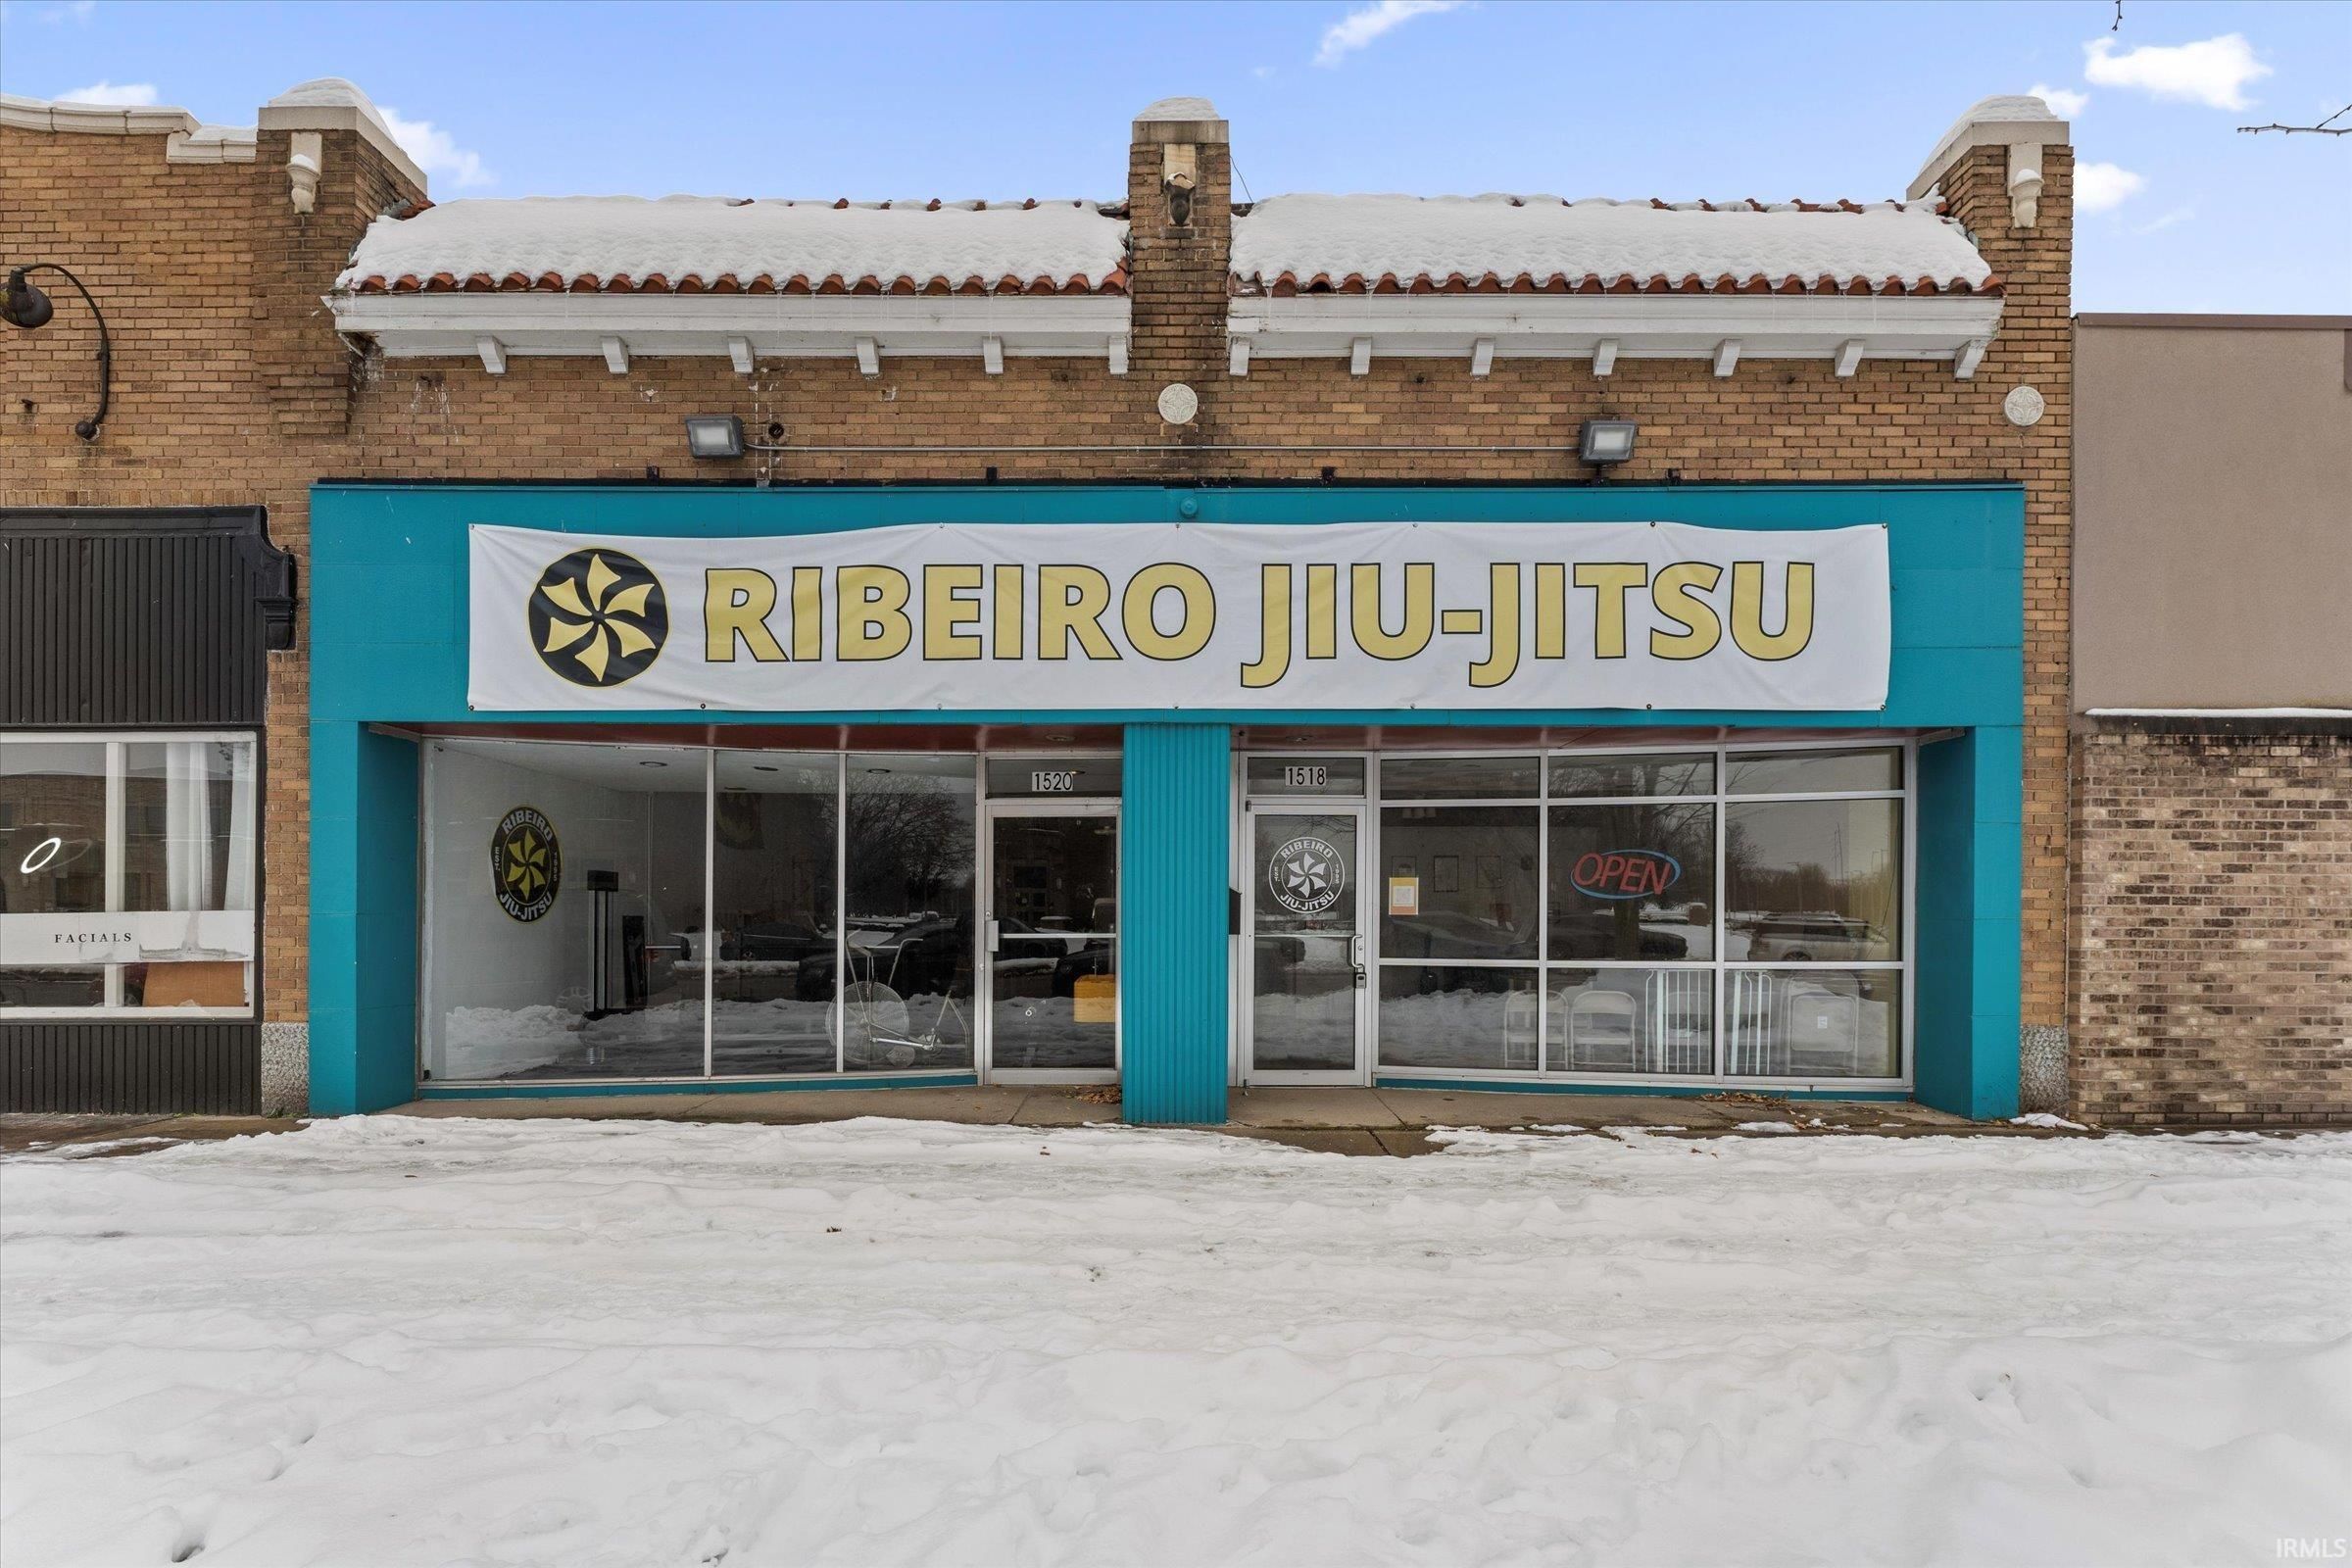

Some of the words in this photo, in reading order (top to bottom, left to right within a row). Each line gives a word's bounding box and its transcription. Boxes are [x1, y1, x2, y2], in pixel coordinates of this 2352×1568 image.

[704, 562, 1217, 663] RIBEIRO
[1240, 561, 1815, 689] JIU-JITSU
[1035, 772, 1073, 791] 1520
[1288, 767, 1326, 785] 1518
[502, 809, 554, 842] RIBEIRO
[1280, 840, 1334, 859] RIBEIRO
[1573, 852, 1672, 896] OPEN
[499, 891, 554, 921] JIU-JITSU
[1280, 890, 1335, 911] JIU-JITSU
[54, 932, 132, 944] FACIALS
